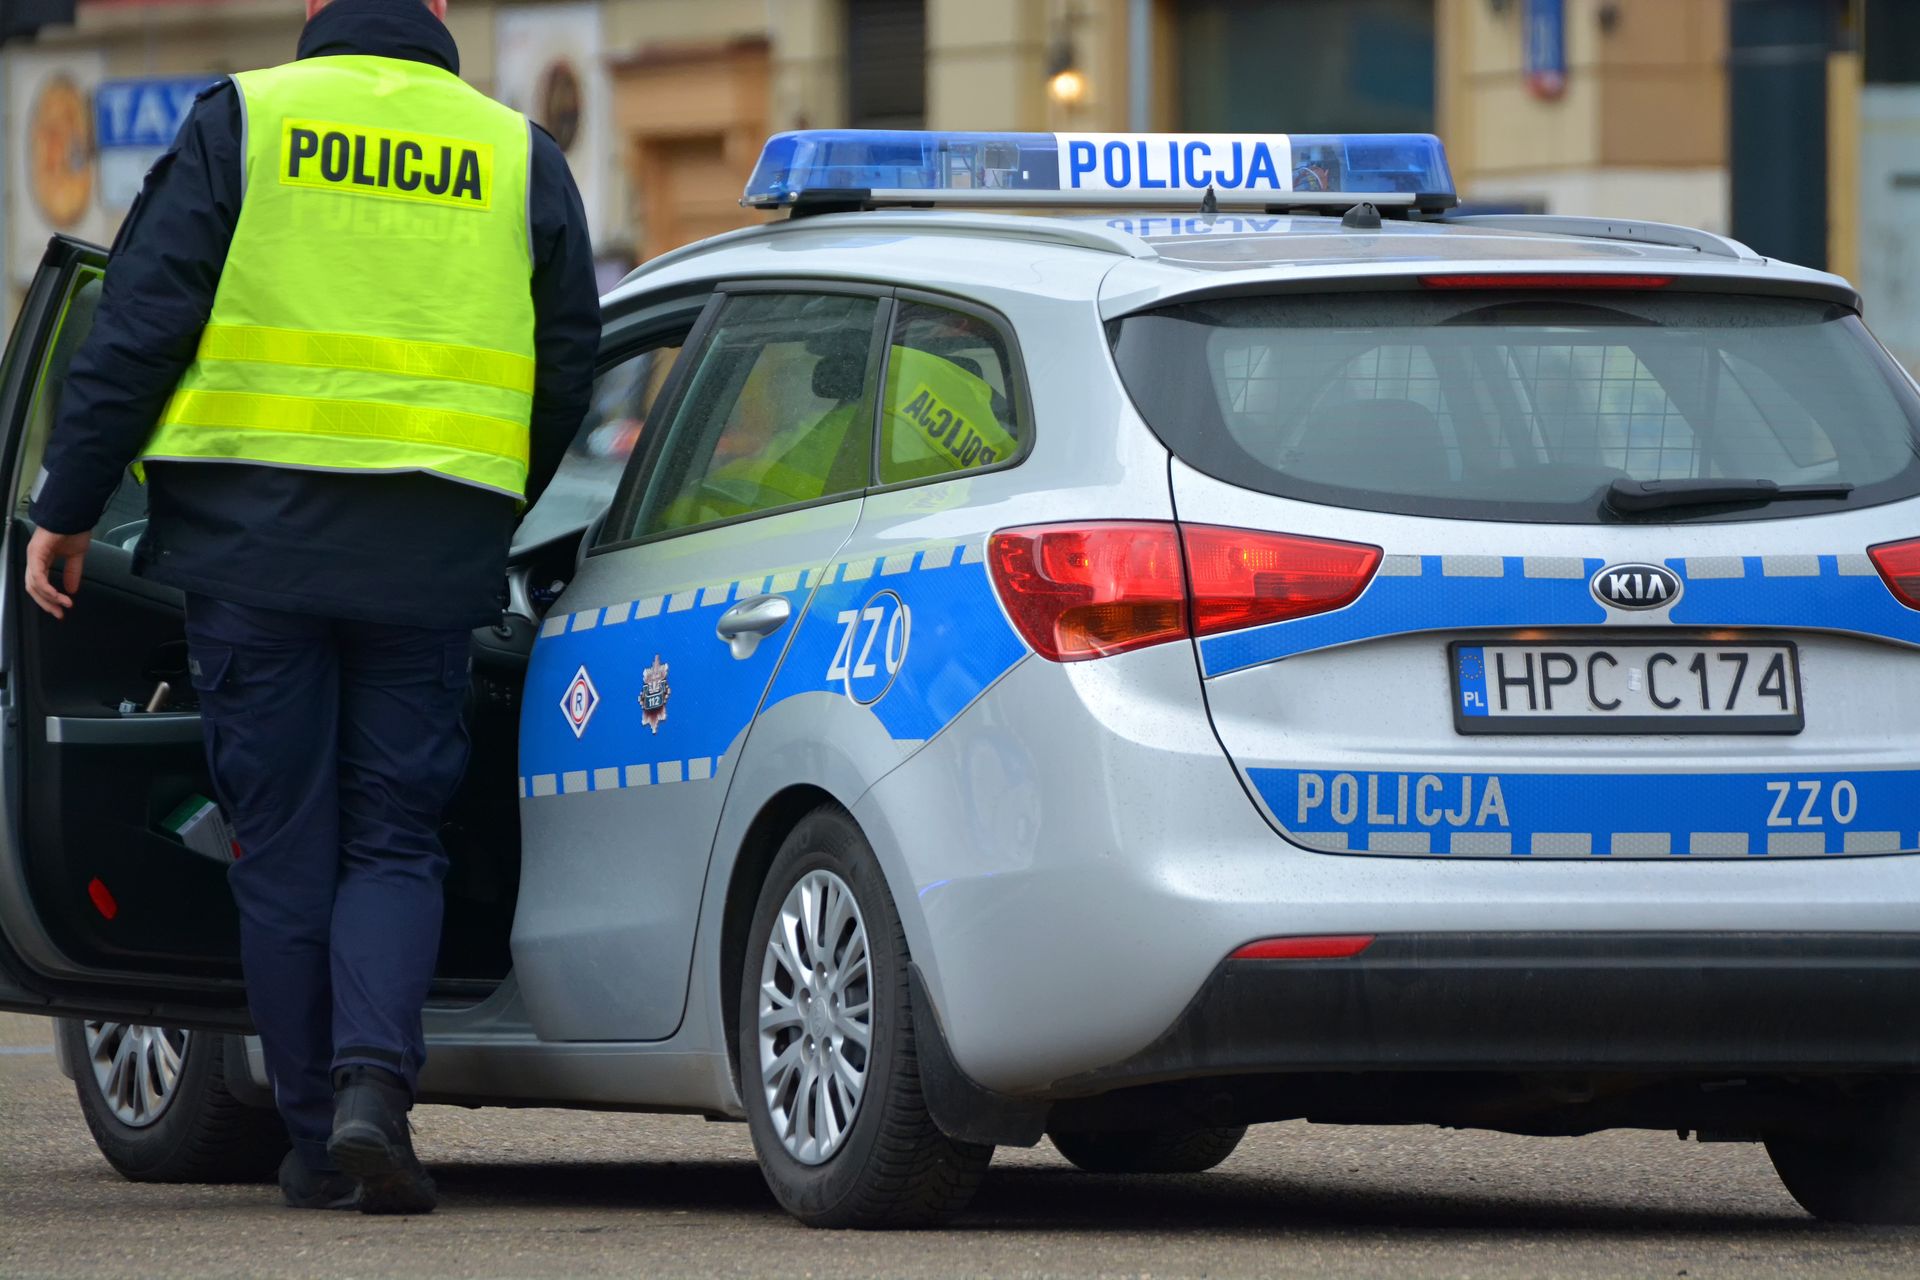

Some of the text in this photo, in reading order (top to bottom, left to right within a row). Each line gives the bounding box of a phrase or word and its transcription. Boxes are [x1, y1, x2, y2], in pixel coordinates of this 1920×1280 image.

[288, 127, 482, 200] POLICJA
[1069, 140, 1281, 189] POLICJA
[1609, 573, 1667, 600] KIA
[1464, 691, 1485, 707] PL
[1495, 651, 1789, 711] HPC C174
[575, 692, 583, 711] R
[648, 696, 660, 707] 112
[1297, 773, 1510, 827] POLICJA
